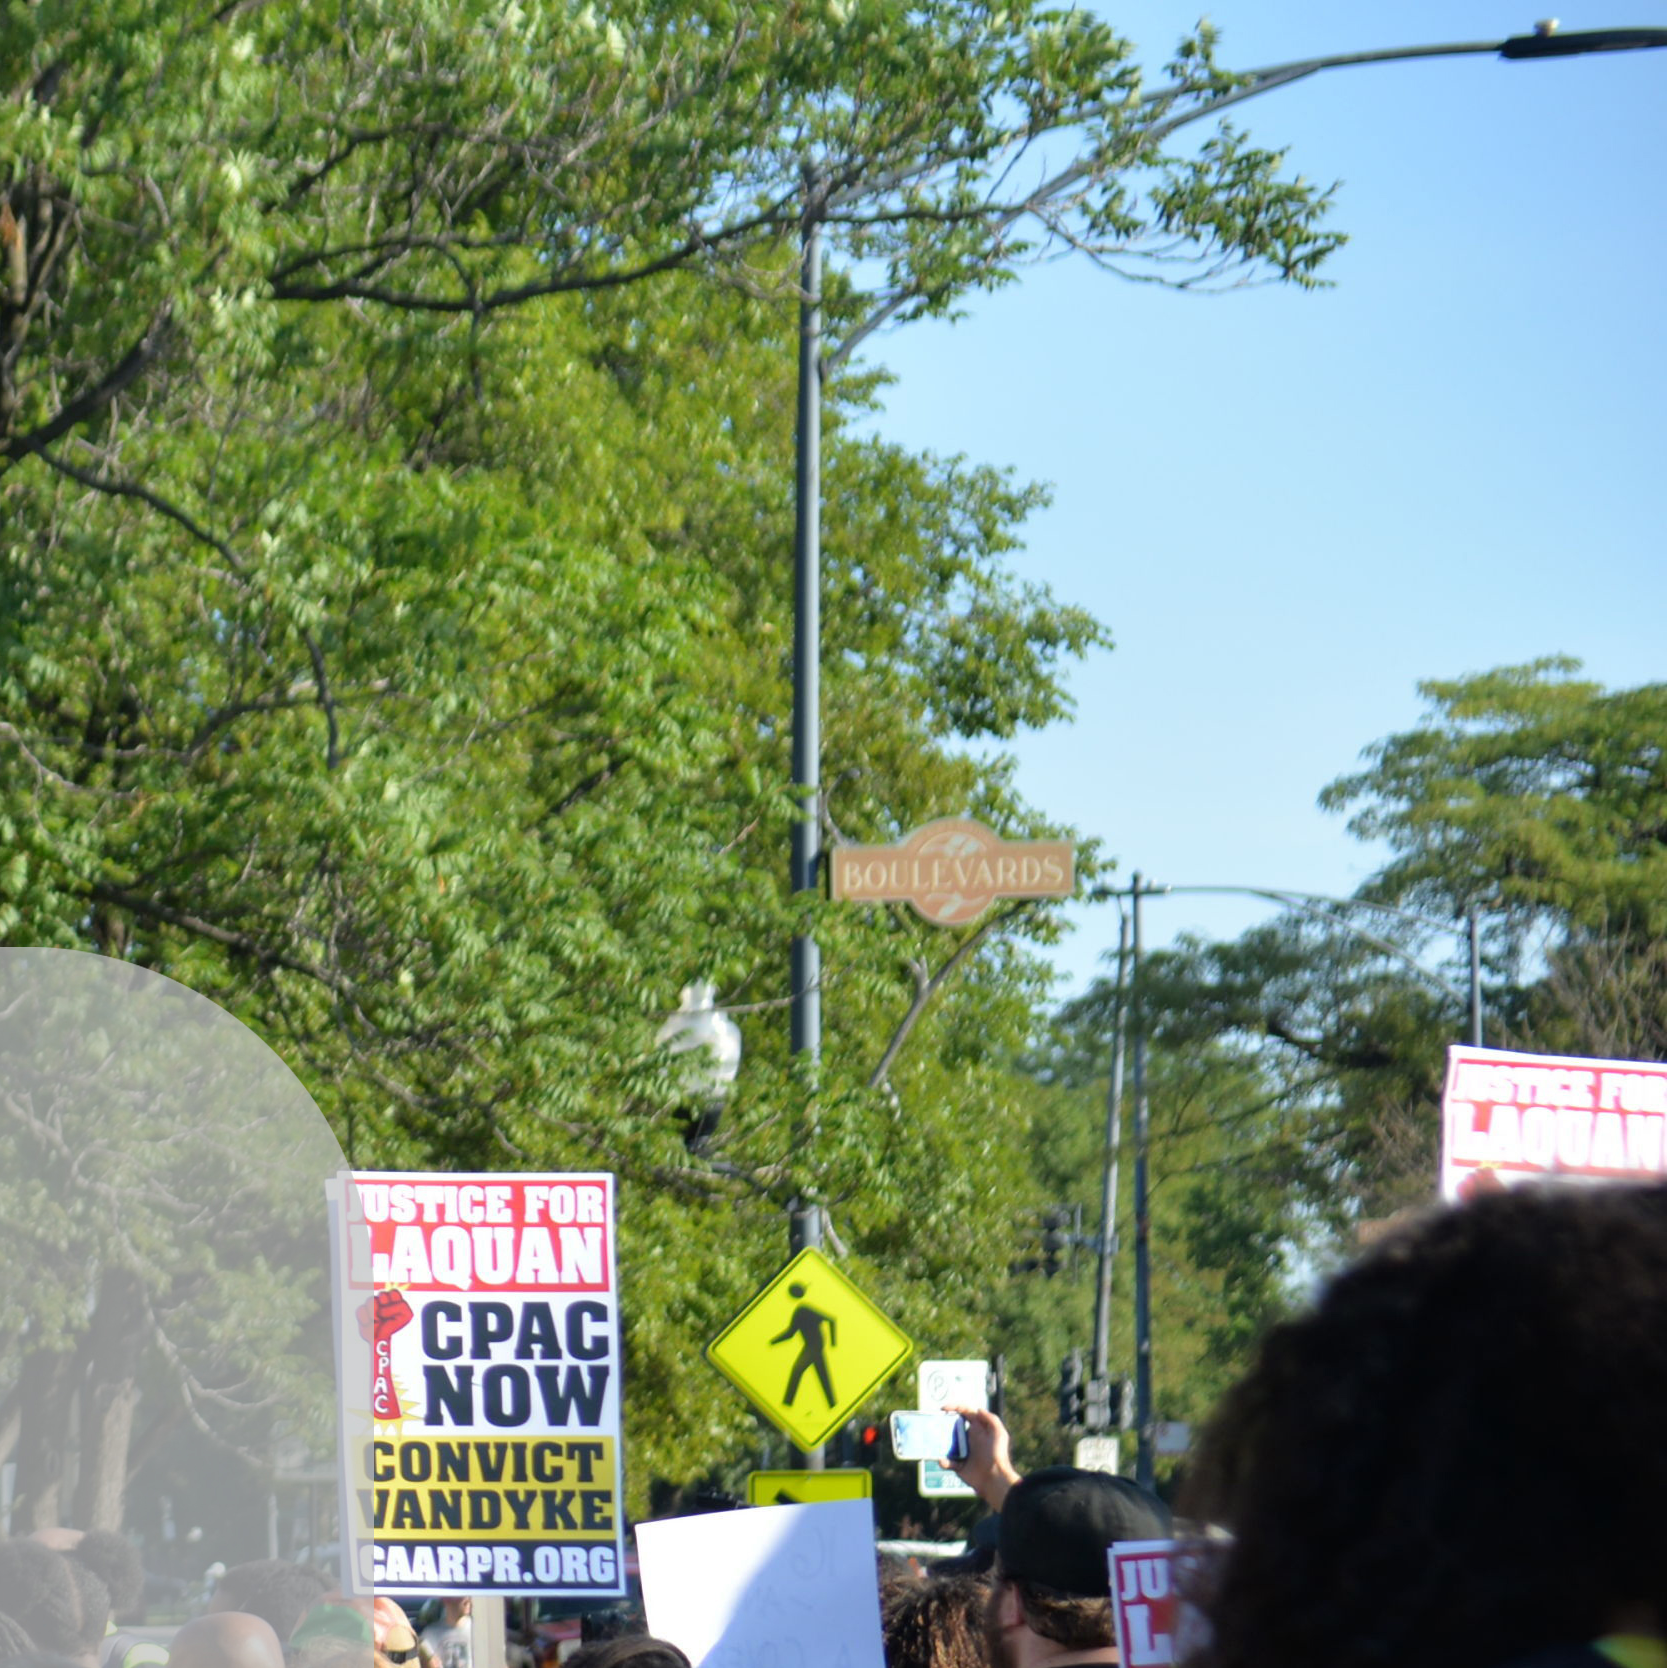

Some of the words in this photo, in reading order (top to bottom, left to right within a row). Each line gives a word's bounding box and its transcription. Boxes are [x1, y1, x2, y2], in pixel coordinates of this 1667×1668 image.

[844, 855, 1064, 890] BOULEVARDS
[1450, 1101, 1665, 1170] LAQUAN
[347, 1184, 512, 1224] JUSTICE
[524, 1184, 605, 1224] FOR
[349, 1225, 603, 1291] LAQUAN
[421, 1300, 609, 1361] CPAC
[373, 1340, 390, 1413] CPAC
[422, 1364, 610, 1427] NOW
[363, 1441, 603, 1483] CONVICT
[355, 1489, 613, 1531] VANDYKE
[359, 1544, 615, 1583] CAARPR.ORG
